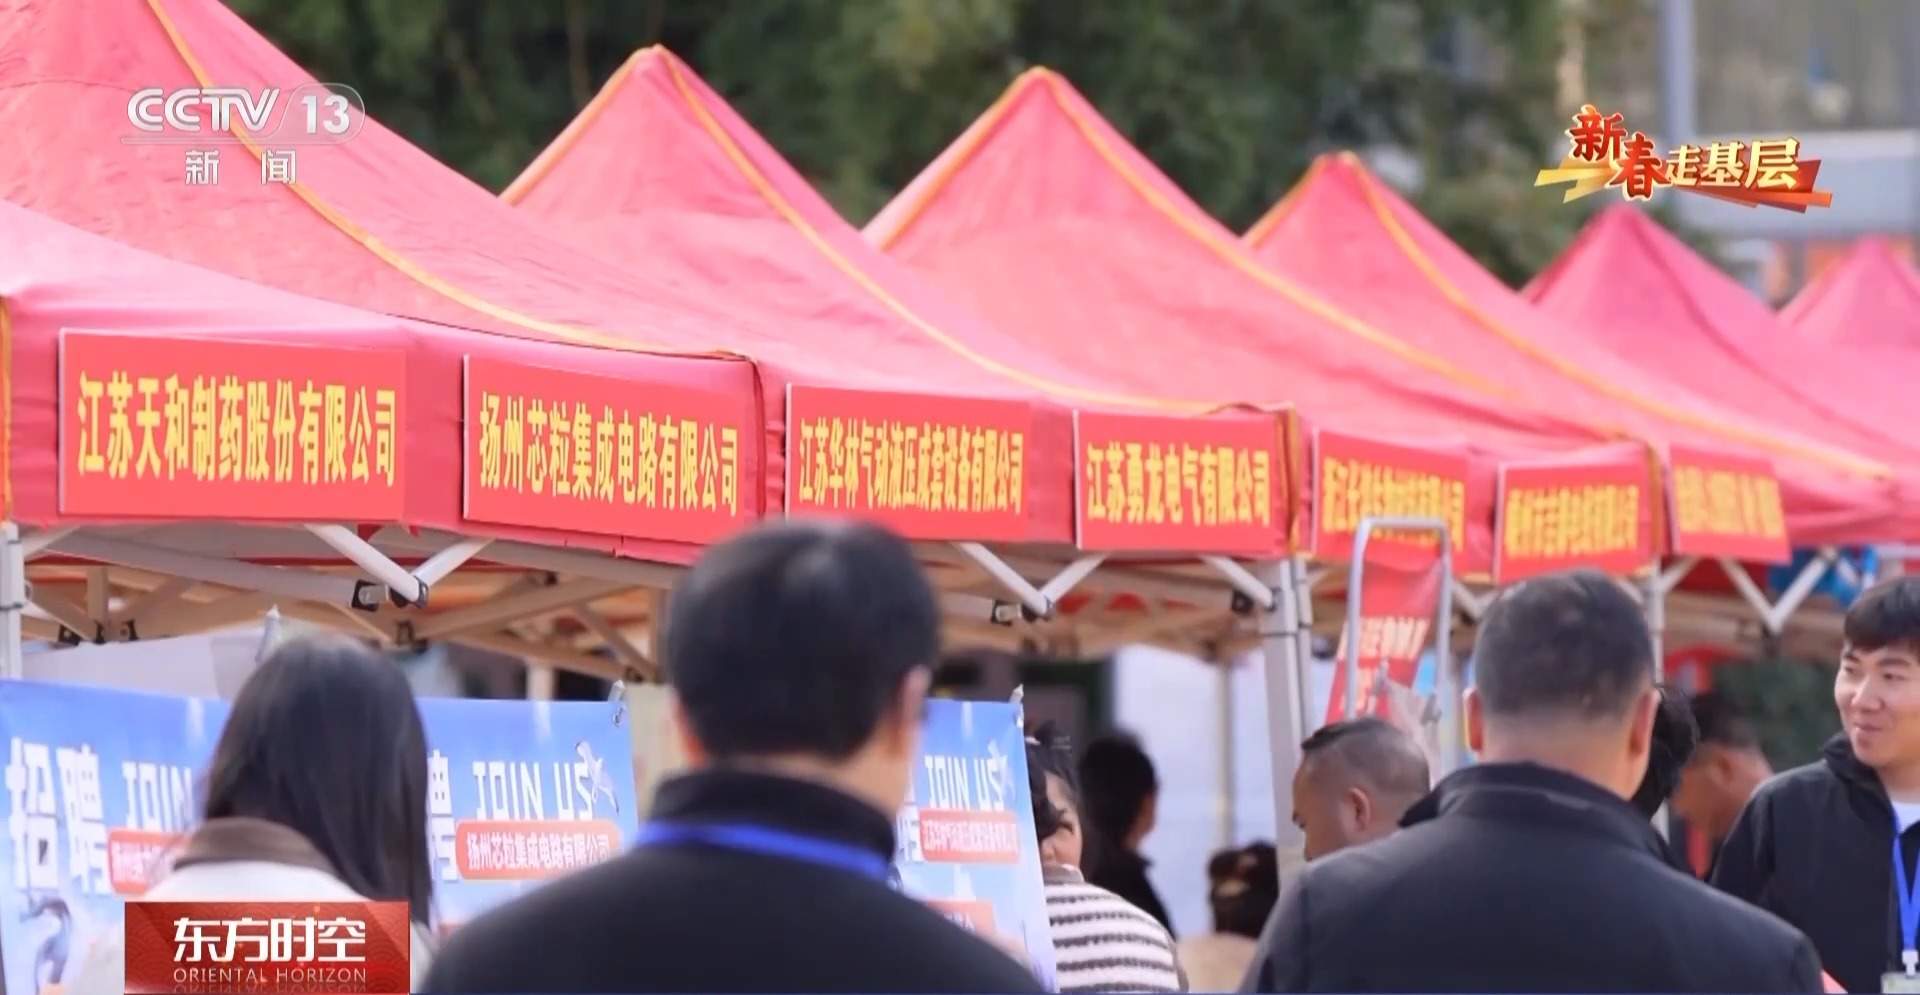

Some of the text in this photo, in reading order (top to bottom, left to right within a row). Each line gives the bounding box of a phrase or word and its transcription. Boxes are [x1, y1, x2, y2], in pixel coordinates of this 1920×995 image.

[78, 371, 397, 486] 江苏天和制药股份有限公司
[479, 391, 739, 517] 扬州芯粒集成电路有限公司
[1086, 442, 1271, 527] 江苏勇龙电气有限公司
[5, 737, 113, 895] 招聘
[472, 761, 598, 820] JOIN US
[924, 756, 970, 812] JOIN
